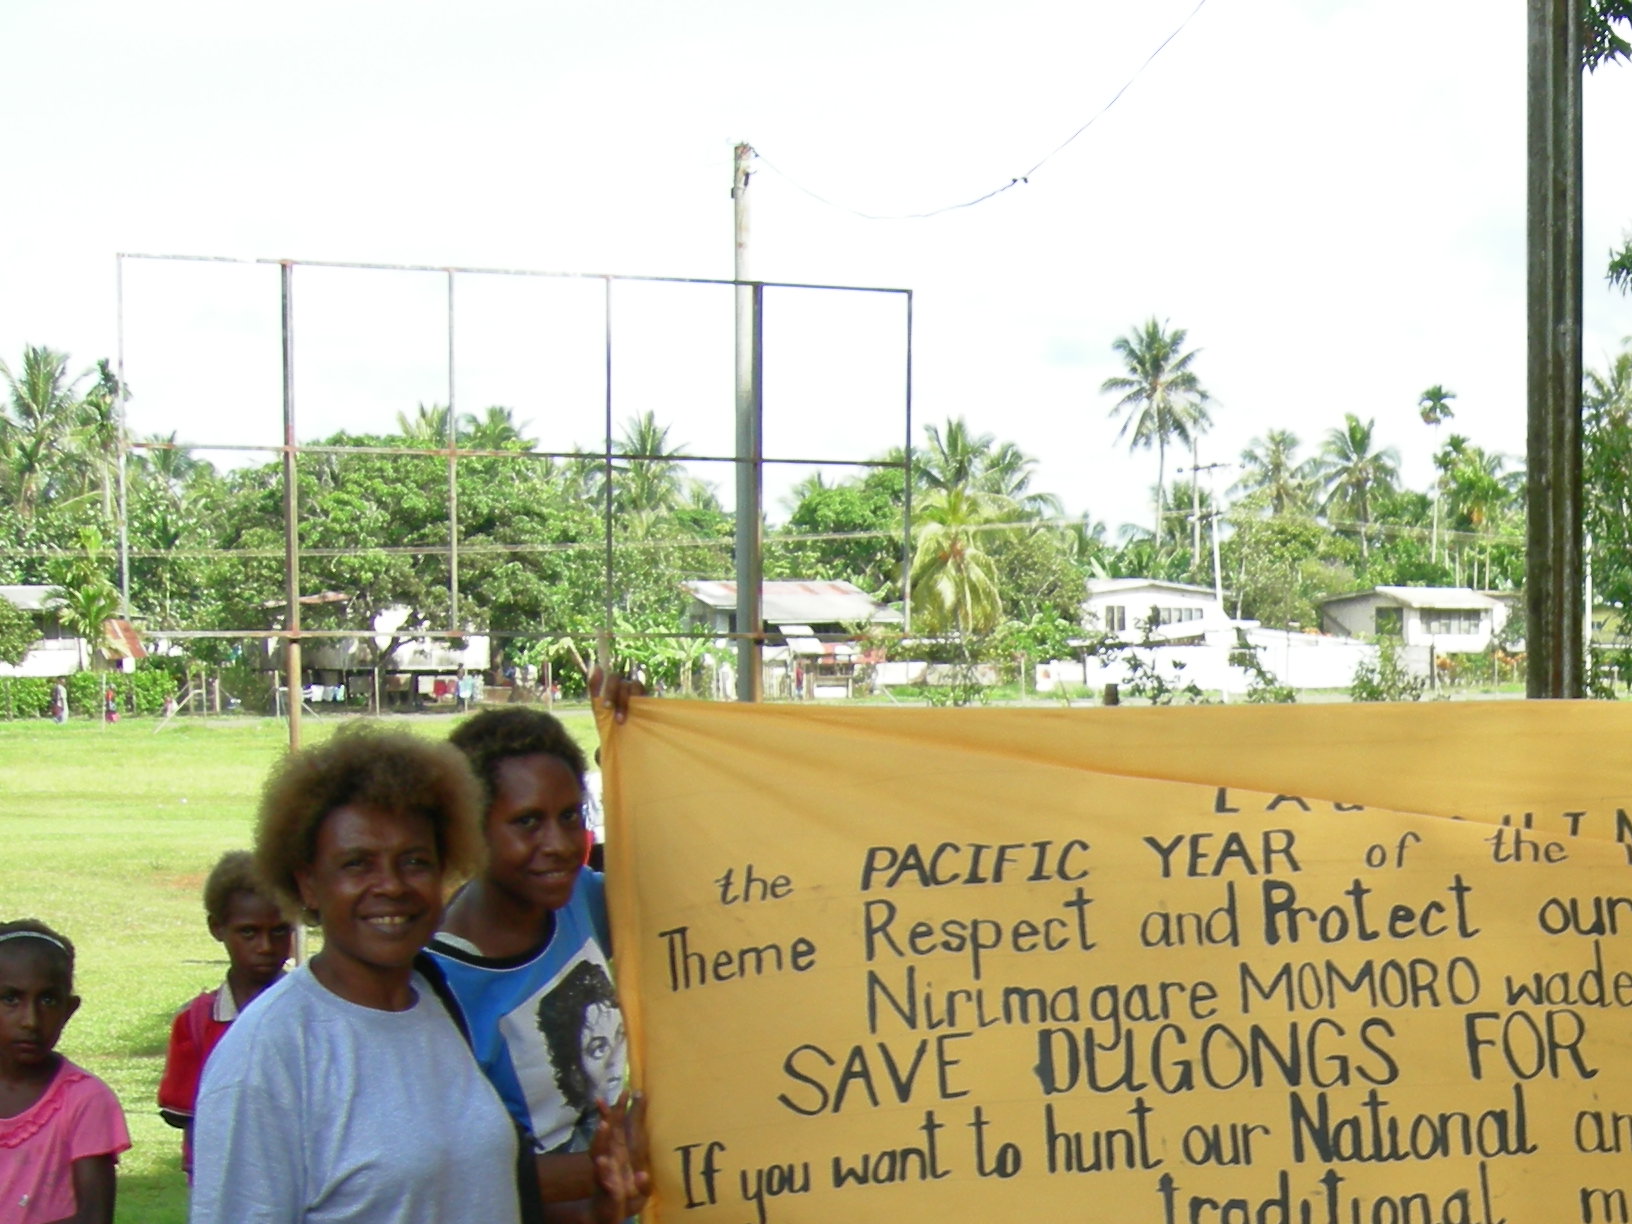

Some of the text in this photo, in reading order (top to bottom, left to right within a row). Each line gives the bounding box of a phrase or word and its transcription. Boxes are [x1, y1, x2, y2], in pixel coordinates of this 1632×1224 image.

[714, 864, 793, 906] the
[860, 840, 1090, 892] PACIFIC
[1143, 828, 1302, 879] YEAR
[1365, 831, 1422, 869] of
[1484, 828, 1569, 864] the
[657, 926, 816, 993] Theme
[863, 886, 1097, 981] Respect
[1140, 880, 1240, 948] and
[1262, 873, 1480, 947] Protect
[1239, 958, 1480, 1014] MOMORO
[777, 1034, 975, 1116] SAVE
[1033, 1017, 1401, 1096] DUGONGS
[1464, 1009, 1600, 1081] FOR
[674, 1140, 726, 1210] If
[832, 1110, 951, 1189] want
[967, 1105, 1023, 1179] to
[1043, 1096, 1165, 1174] hunt
[1182, 1121, 1271, 1167] our
[1288, 1082, 1539, 1164] National
